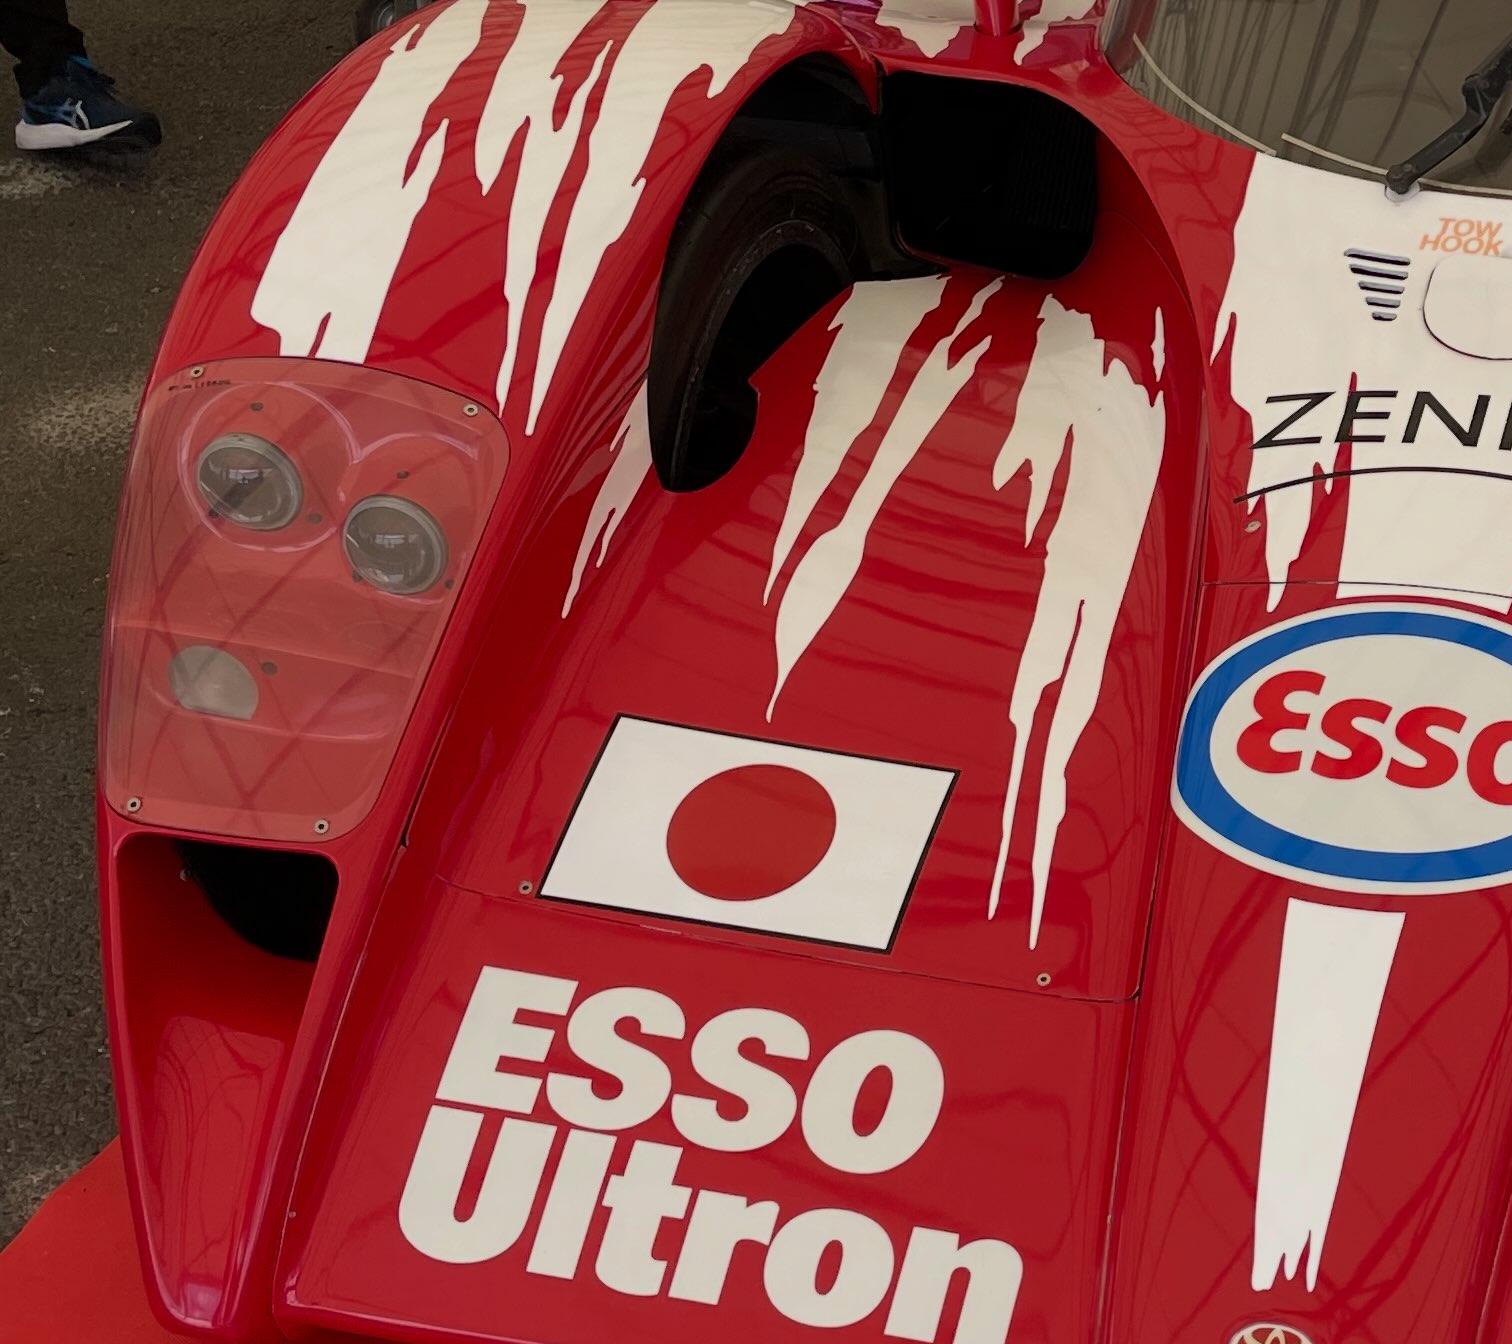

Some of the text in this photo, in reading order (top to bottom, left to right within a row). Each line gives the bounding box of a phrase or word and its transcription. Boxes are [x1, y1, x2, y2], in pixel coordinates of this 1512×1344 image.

[1437, 217, 1504, 237] TOW
[1419, 233, 1504, 257] HOOK
[434, 965, 945, 1174] ESSO
